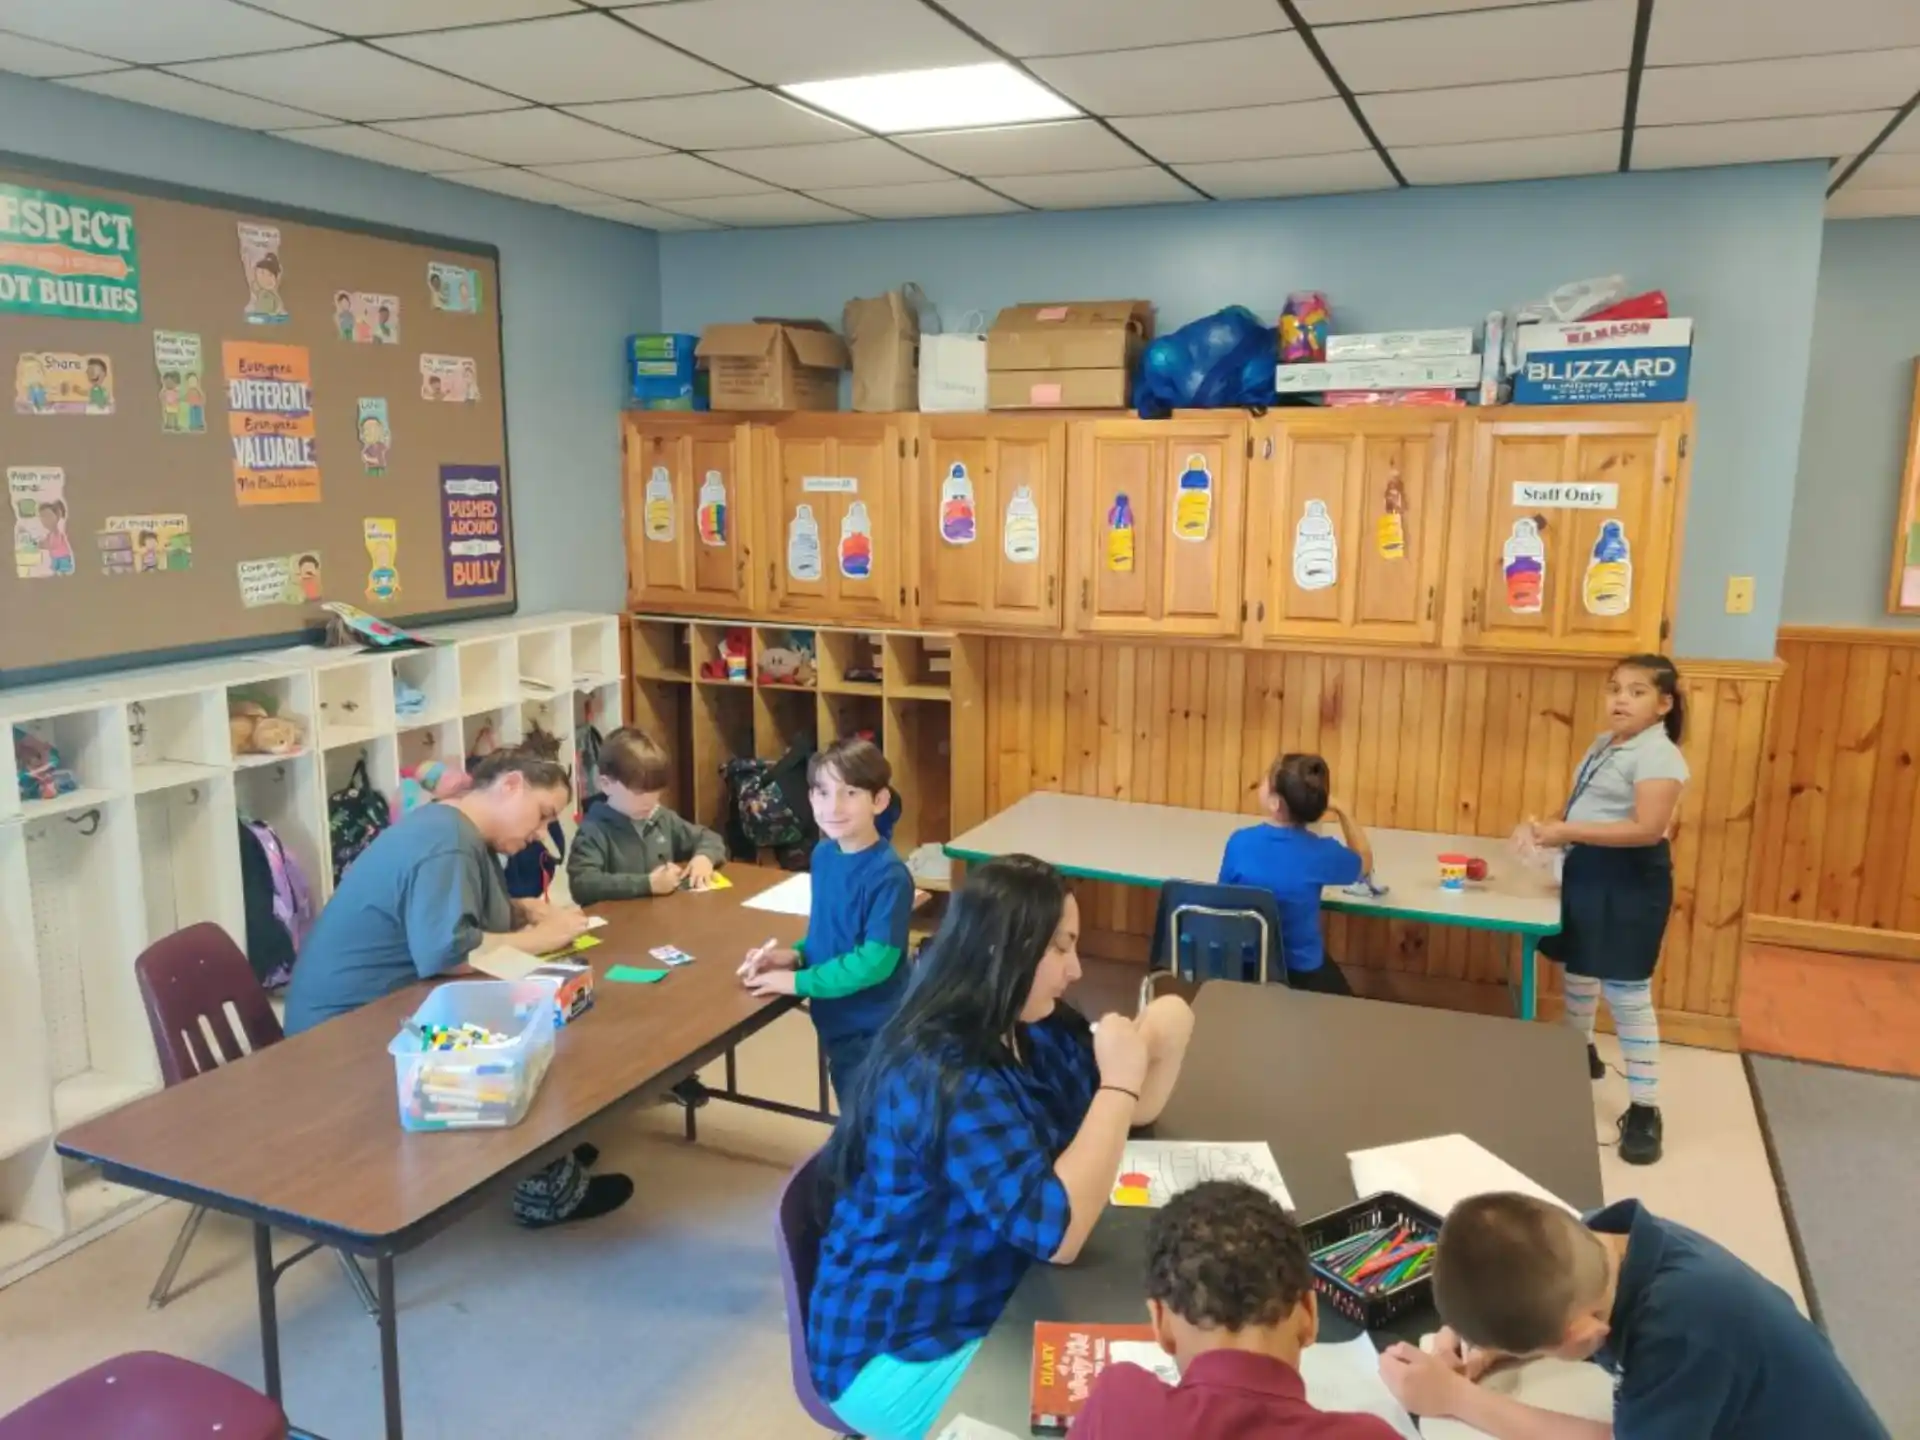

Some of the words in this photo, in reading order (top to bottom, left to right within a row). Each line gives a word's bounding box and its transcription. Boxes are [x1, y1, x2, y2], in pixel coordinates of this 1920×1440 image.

[38, 277, 138, 314] BULLIES
[44, 355, 82, 370] Share
[1527, 357, 1677, 381] BLIZZARD
[1523, 487, 1560, 501] Staff
[1564, 487, 1604, 505] Only
[448, 500, 497, 518] PUSHED
[450, 520, 499, 536] AROUND
[452, 559, 501, 586] BULLY
[1040, 1341, 1056, 1387] DIARY
